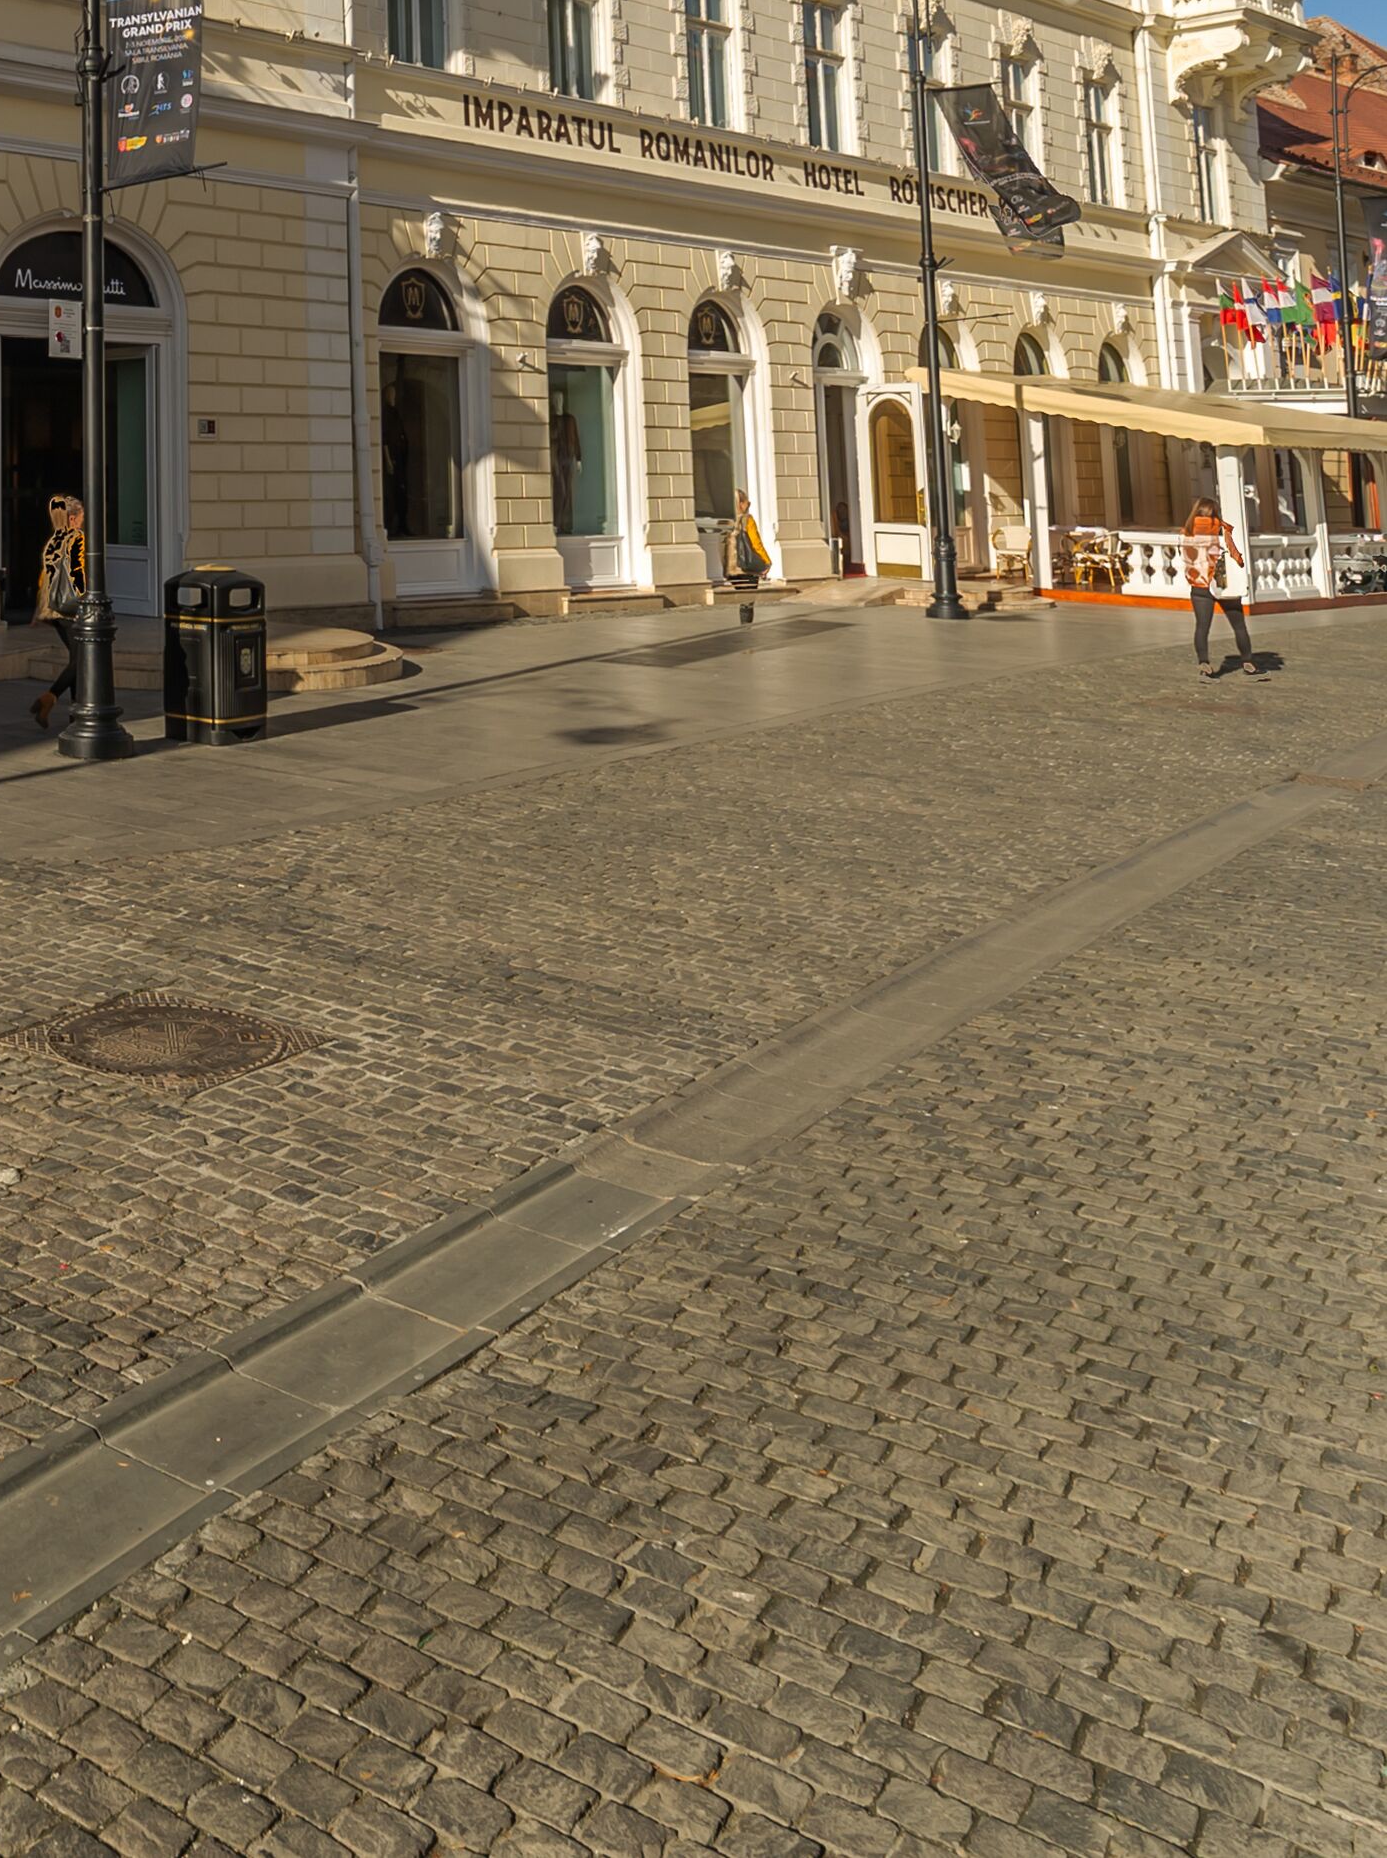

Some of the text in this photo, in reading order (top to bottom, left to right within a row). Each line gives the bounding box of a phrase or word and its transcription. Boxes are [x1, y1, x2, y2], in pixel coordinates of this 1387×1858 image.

[109, 3, 202, 29] TRANSYLVANIAN
[122, 19, 192, 39] GRAND PRIX
[463, 94, 621, 154] IMPARATUL
[639, 128, 775, 181] ROMANILOR
[803, 161, 864, 196] HOTEL
[15, 268, 126, 295] Massimo utti
